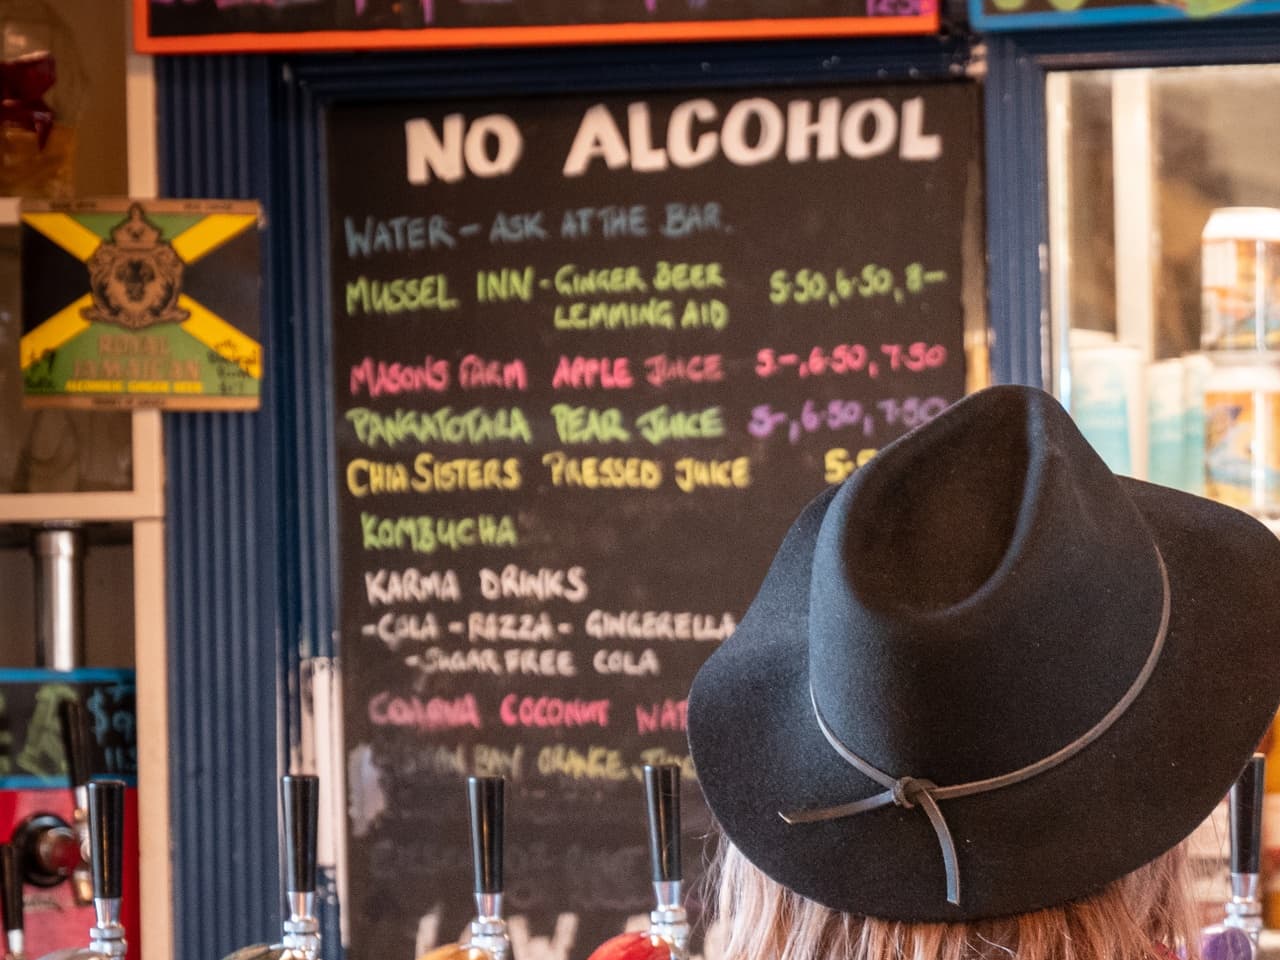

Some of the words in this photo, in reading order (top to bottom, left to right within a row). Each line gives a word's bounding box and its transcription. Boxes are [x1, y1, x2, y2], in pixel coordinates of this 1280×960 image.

[405, 114, 524, 185] NO
[562, 97, 942, 177] ALCOHOL
[344, 215, 456, 257] WATER
[489, 211, 547, 243] ASK
[561, 209, 595, 238] AT
[598, 205, 647, 239] THE
[476, 265, 534, 302] INN
[554, 263, 647, 296] GINGER
[653, 260, 726, 291] BEER
[553, 298, 675, 330] LEMMING
[680, 298, 729, 331] AID
[552, 355, 634, 389] APPLE
[644, 353, 724, 388] JUICE
[550, 403, 631, 444] PEAR
[635, 403, 725, 445] JUICE
[346, 458, 410, 498] CHIA
[410, 452, 521, 493] SISTERS
[542, 451, 662, 489] PRESSED
[675, 455, 750, 493] JUICE
[360, 511, 518, 554] KOMBUCHA
[364, 567, 462, 606] KARMA
[479, 563, 588, 603] DRINKS
[503, 649, 577, 677] FREE
[592, 649, 660, 676] COLA
[500, 693, 609, 729] COCONUT
